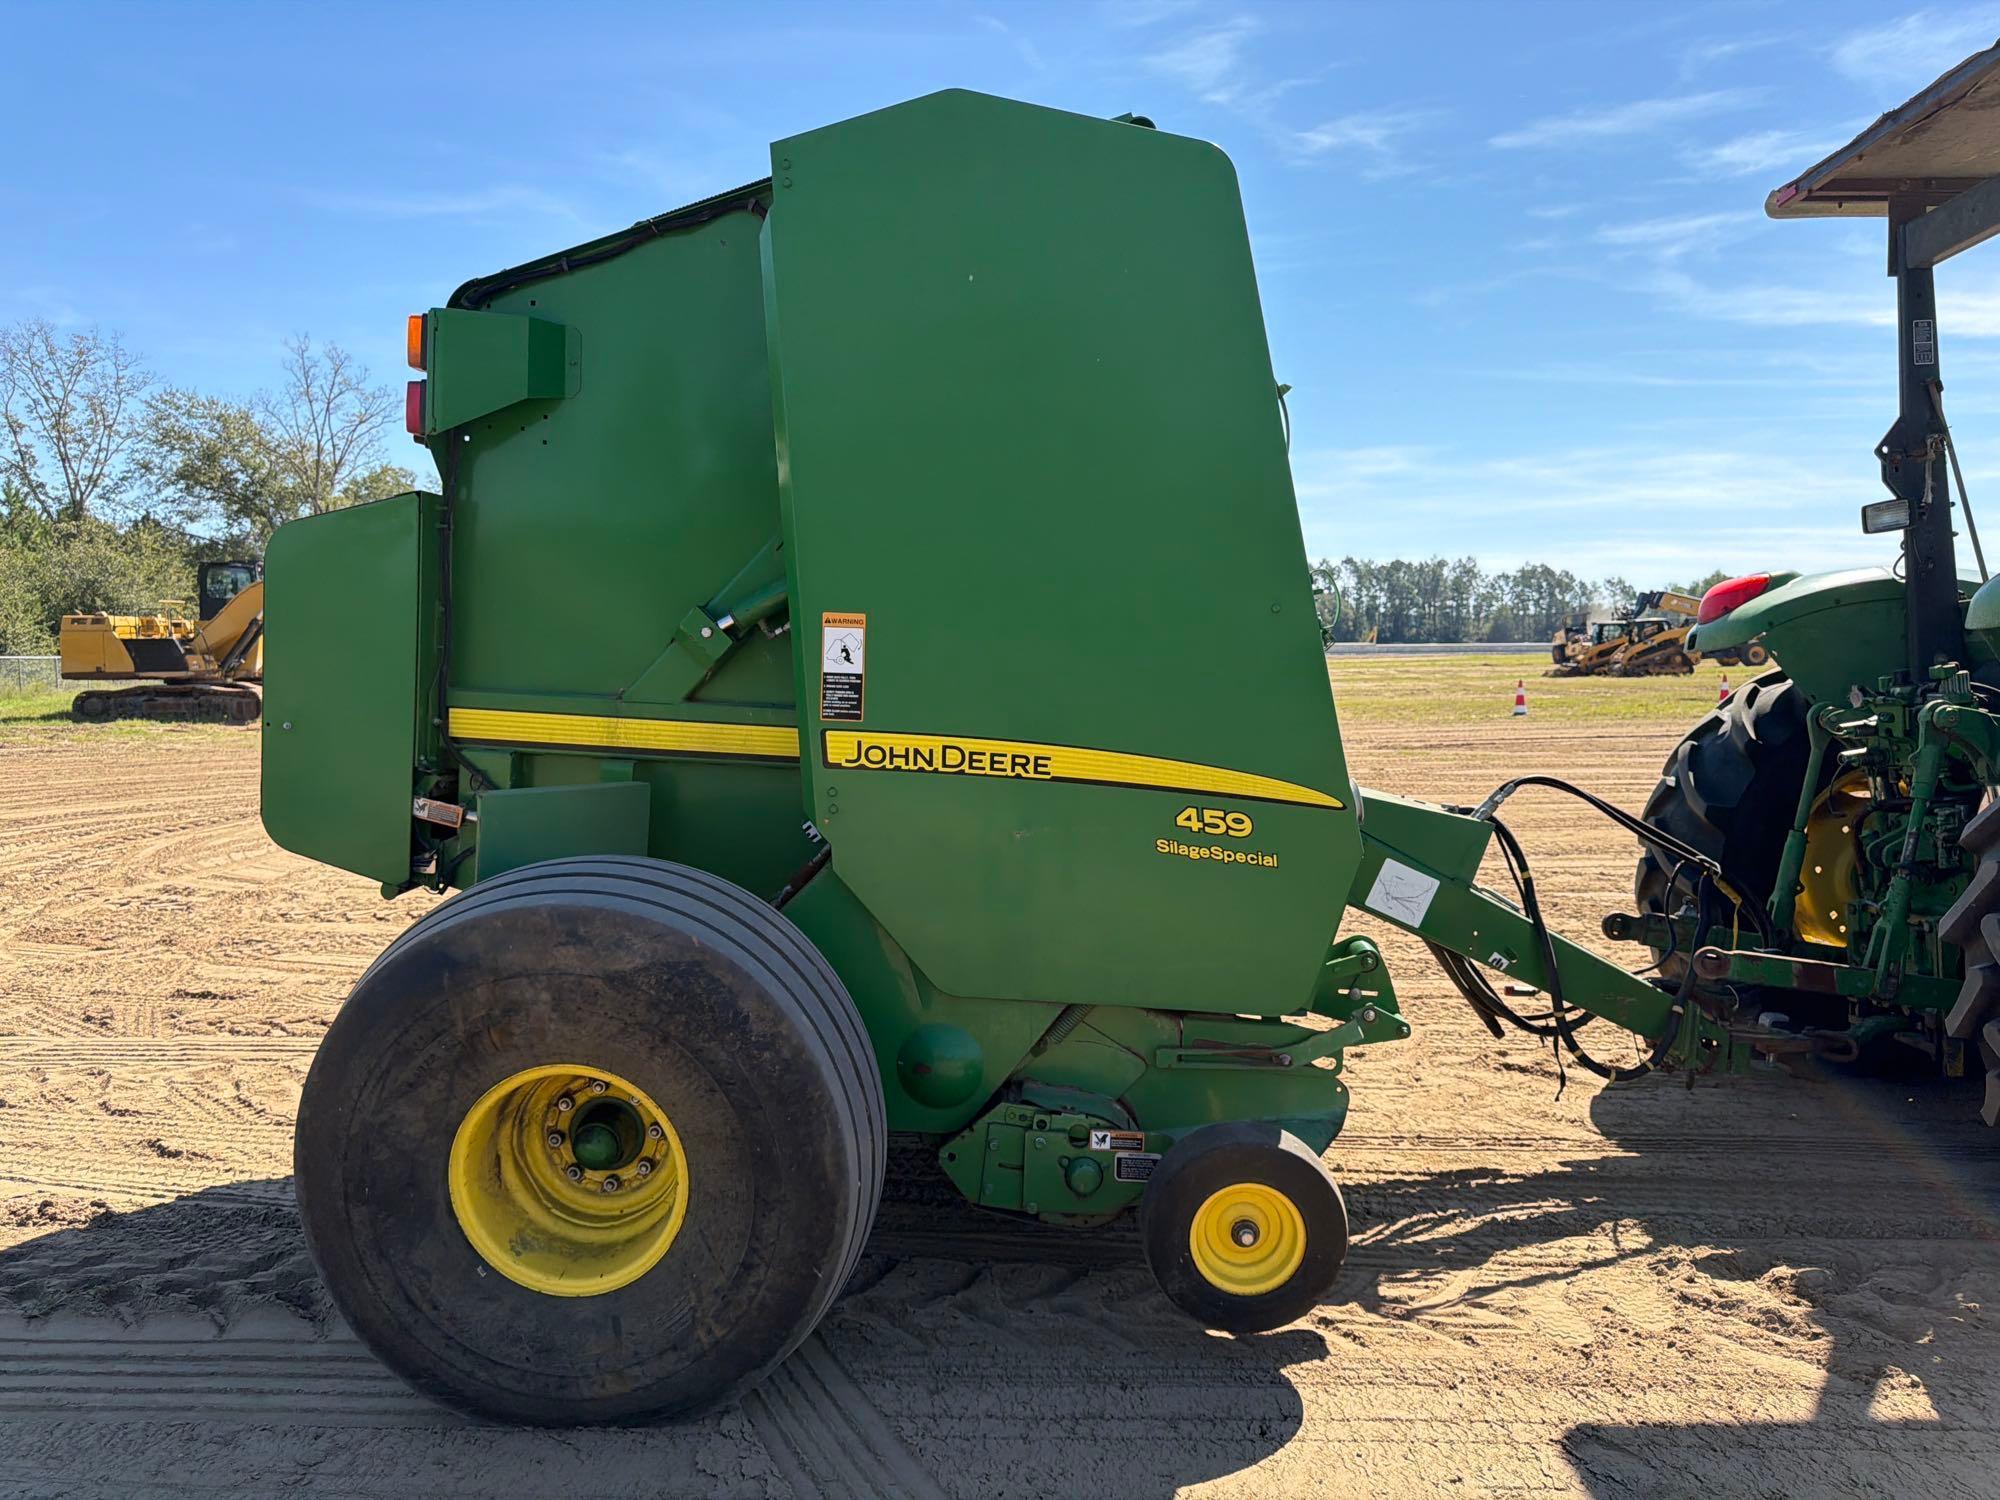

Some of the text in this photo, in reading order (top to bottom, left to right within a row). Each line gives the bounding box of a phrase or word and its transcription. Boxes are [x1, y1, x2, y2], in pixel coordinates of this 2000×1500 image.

[844, 740, 1052, 775] JOHN DEERE
[1176, 806, 1253, 838] 459
[1156, 839, 1279, 868] SilageSpecial
